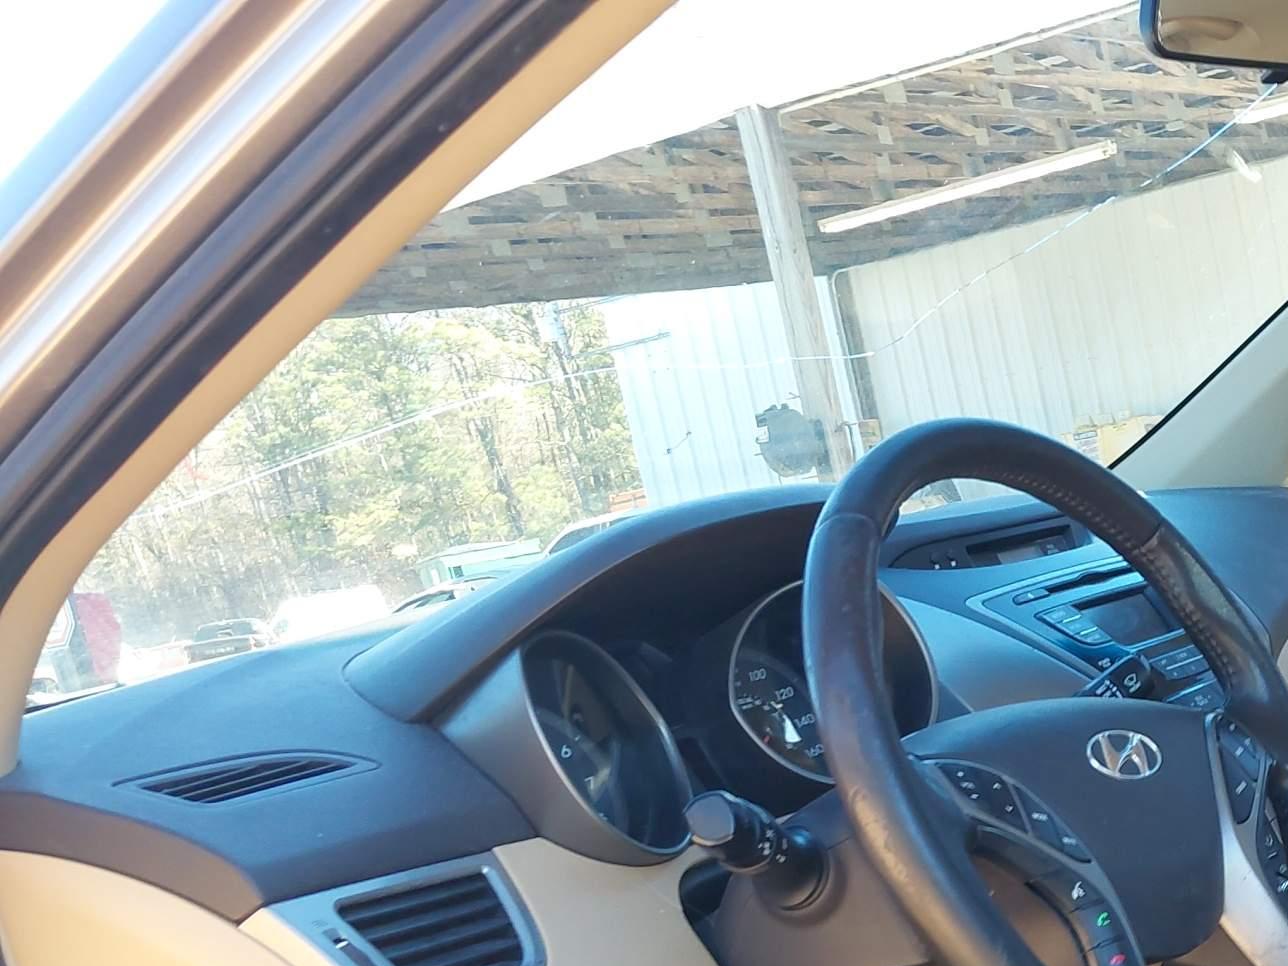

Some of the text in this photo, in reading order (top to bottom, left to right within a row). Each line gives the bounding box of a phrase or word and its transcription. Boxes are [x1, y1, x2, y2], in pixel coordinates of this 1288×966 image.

[749, 668, 767, 682] 100
[775, 686, 794, 701] 120
[795, 713, 815, 728] 140
[560, 744, 573, 759] 6
[584, 775, 595, 790] 7
